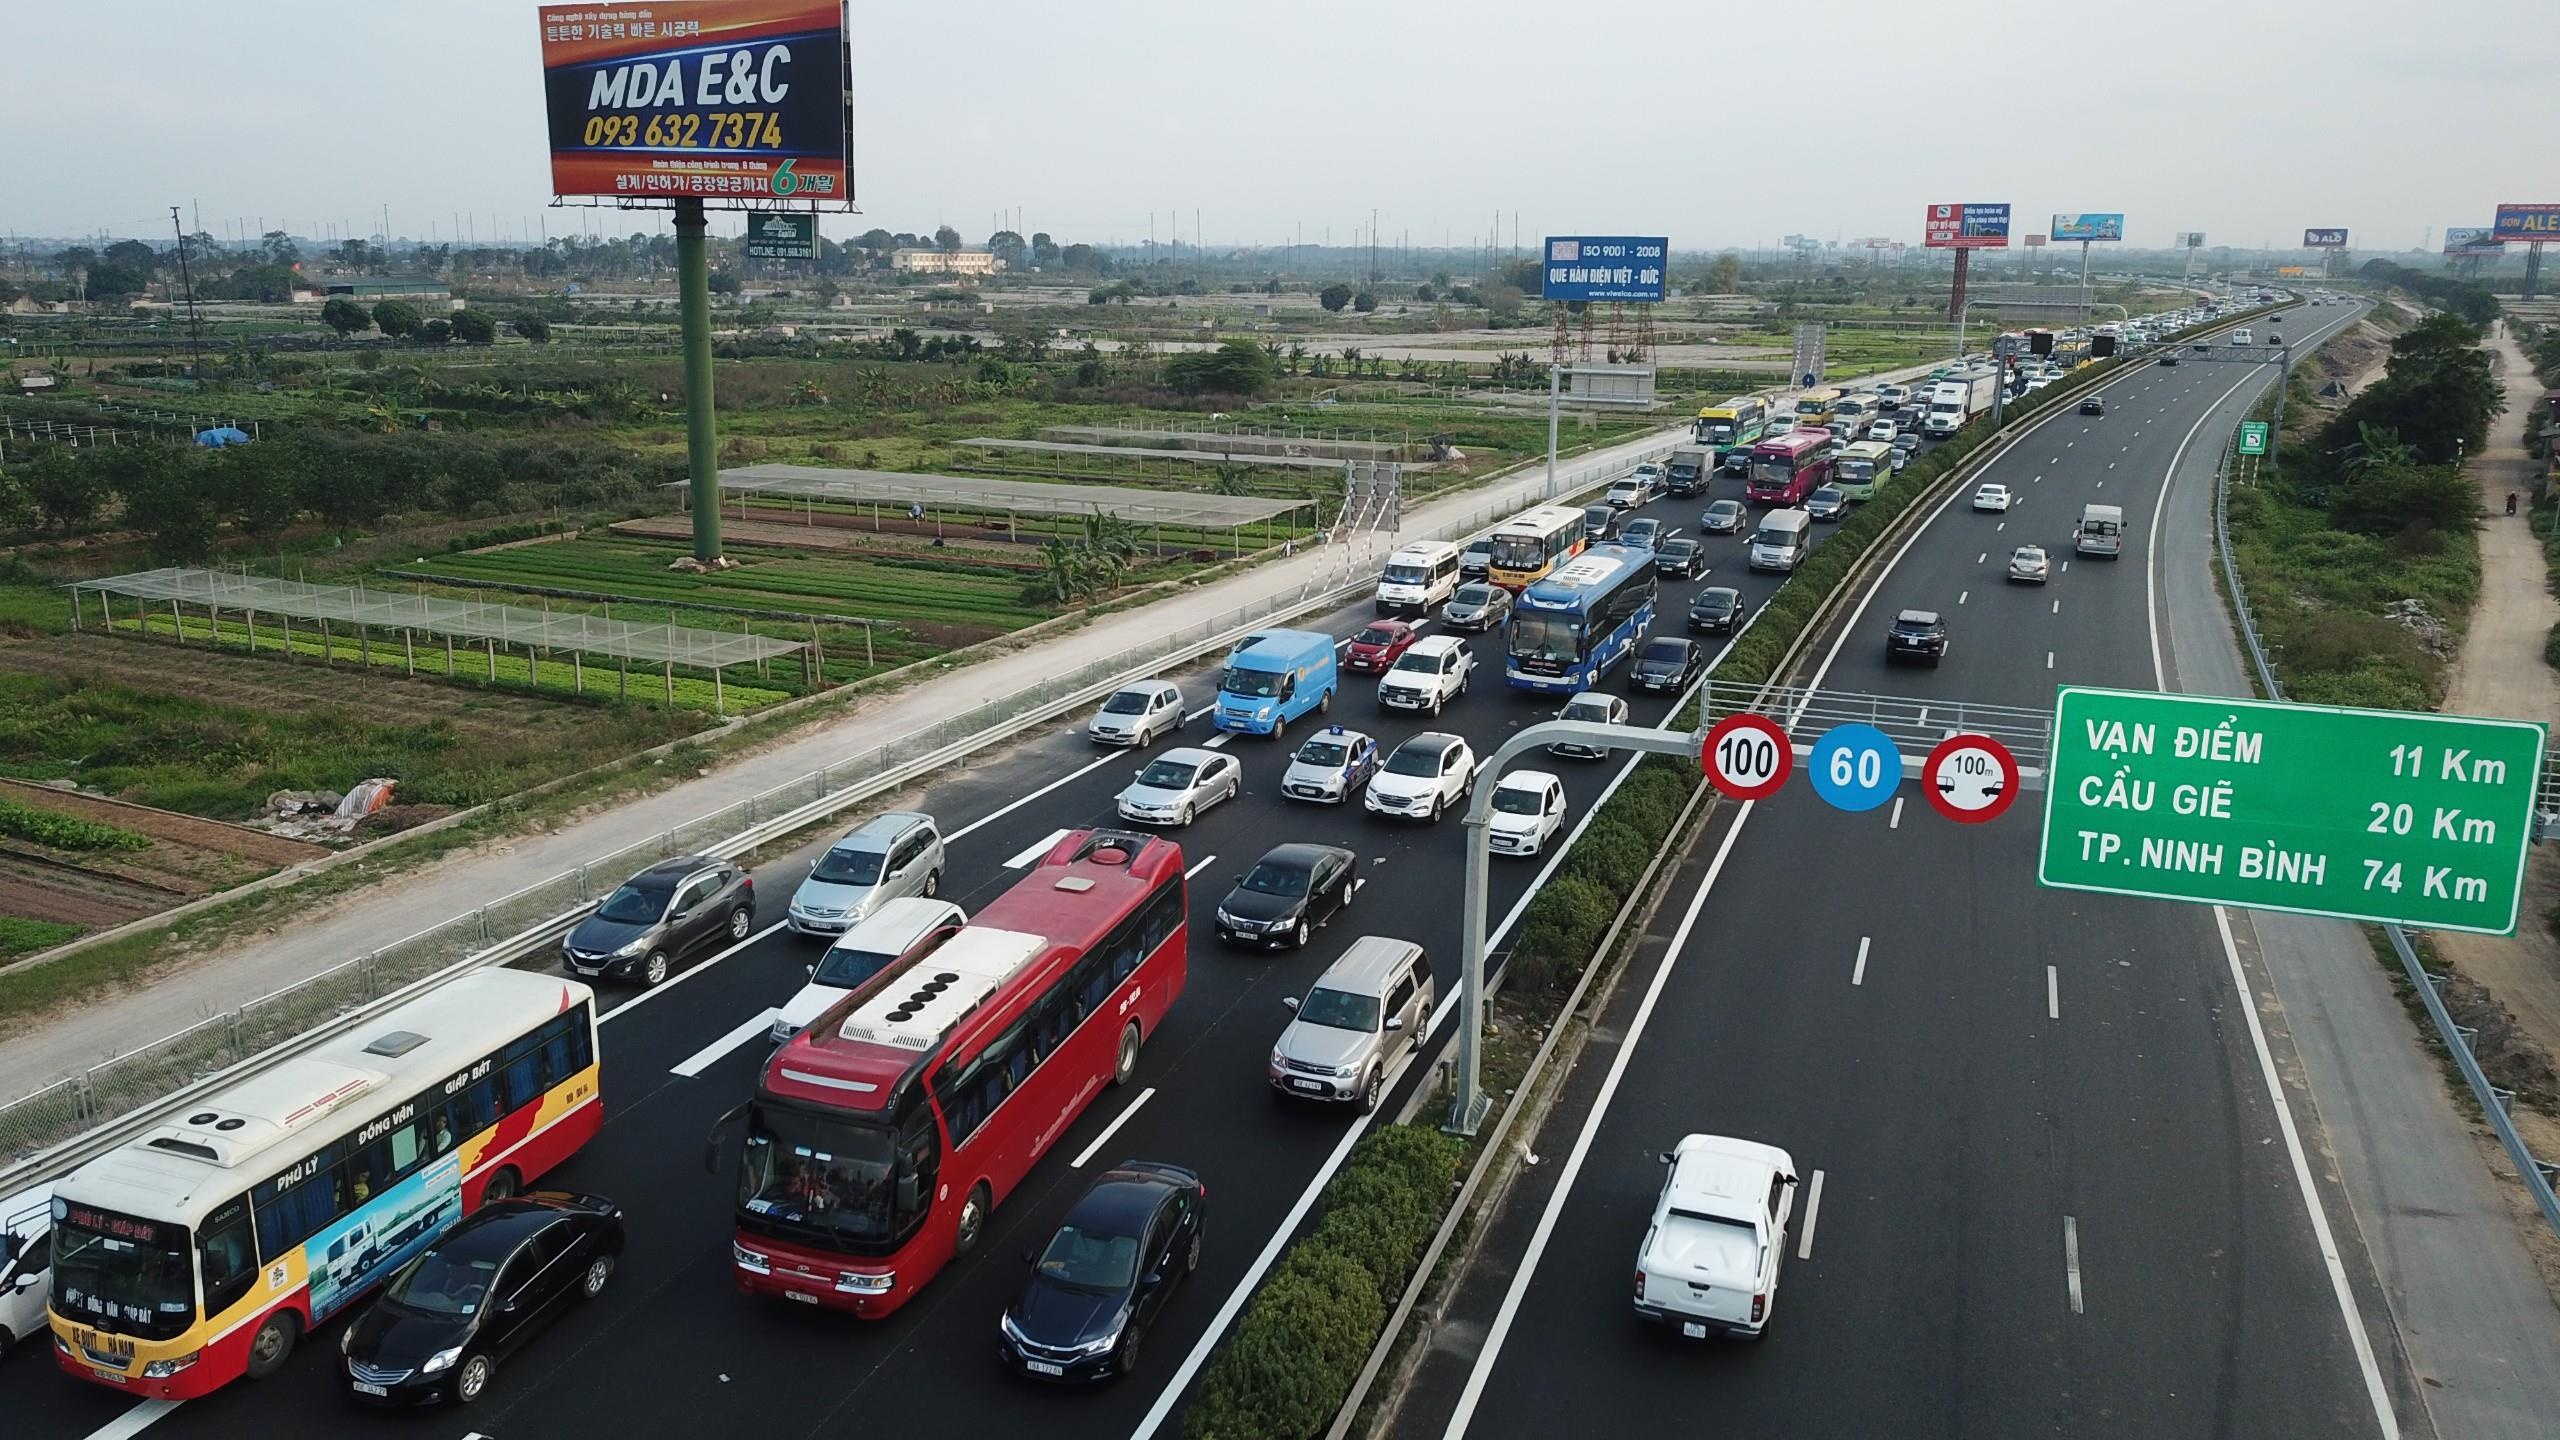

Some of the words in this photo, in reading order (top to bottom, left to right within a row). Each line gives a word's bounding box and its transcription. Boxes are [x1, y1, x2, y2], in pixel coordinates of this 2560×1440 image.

[547, 25, 583, 41] 튼튼한
[588, 23, 625, 40] 기술력
[630, 22, 656, 38] 빠른
[660, 20, 699, 38] 시공력
[588, 59, 684, 110] MDA
[696, 44, 791, 105] E&C
[584, 115, 638, 146] 093
[644, 114, 700, 147] 632
[708, 112, 782, 148] 7374
[2522, 214, 2560, 231] ALE
[750, 246, 776, 256] HOTLINE:
[1583, 246, 1600, 256] ISO
[1602, 246, 1626, 256] 9001
[1636, 246, 1660, 257] 2008
[1550, 268, 1568, 284] QUE
[1569, 266, 1588, 283] HÀN
[1613, 266, 1632, 286] VIỆT
[1640, 265, 1660, 284] ĐỨC
[1720, 738, 1772, 778] 100
[2086, 718, 2156, 760] VẠN
[2174, 714, 2263, 764] ĐIỂM
[2390, 744, 2423, 778] 11
[2441, 748, 2506, 784] Km
[1830, 747, 1881, 788] 60
[2079, 764, 2156, 812] CẦU
[2172, 780, 2233, 818] GIẼ
[2366, 802, 2414, 835] 20
[2432, 808, 2496, 844] Km
[2140, 838, 2224, 876] NINH
[2238, 840, 2327, 886] BÌNH
[2363, 859, 2402, 894] 74
[2422, 866, 2488, 902] Km
[445, 1073, 468, 1094] GIÁP
[305, 1155, 318, 1176] LÝ
[214, 1205, 240, 1223] SAMCO
[72, 1326, 80, 1344] XE
[118, 1340, 135, 1358] NAM
